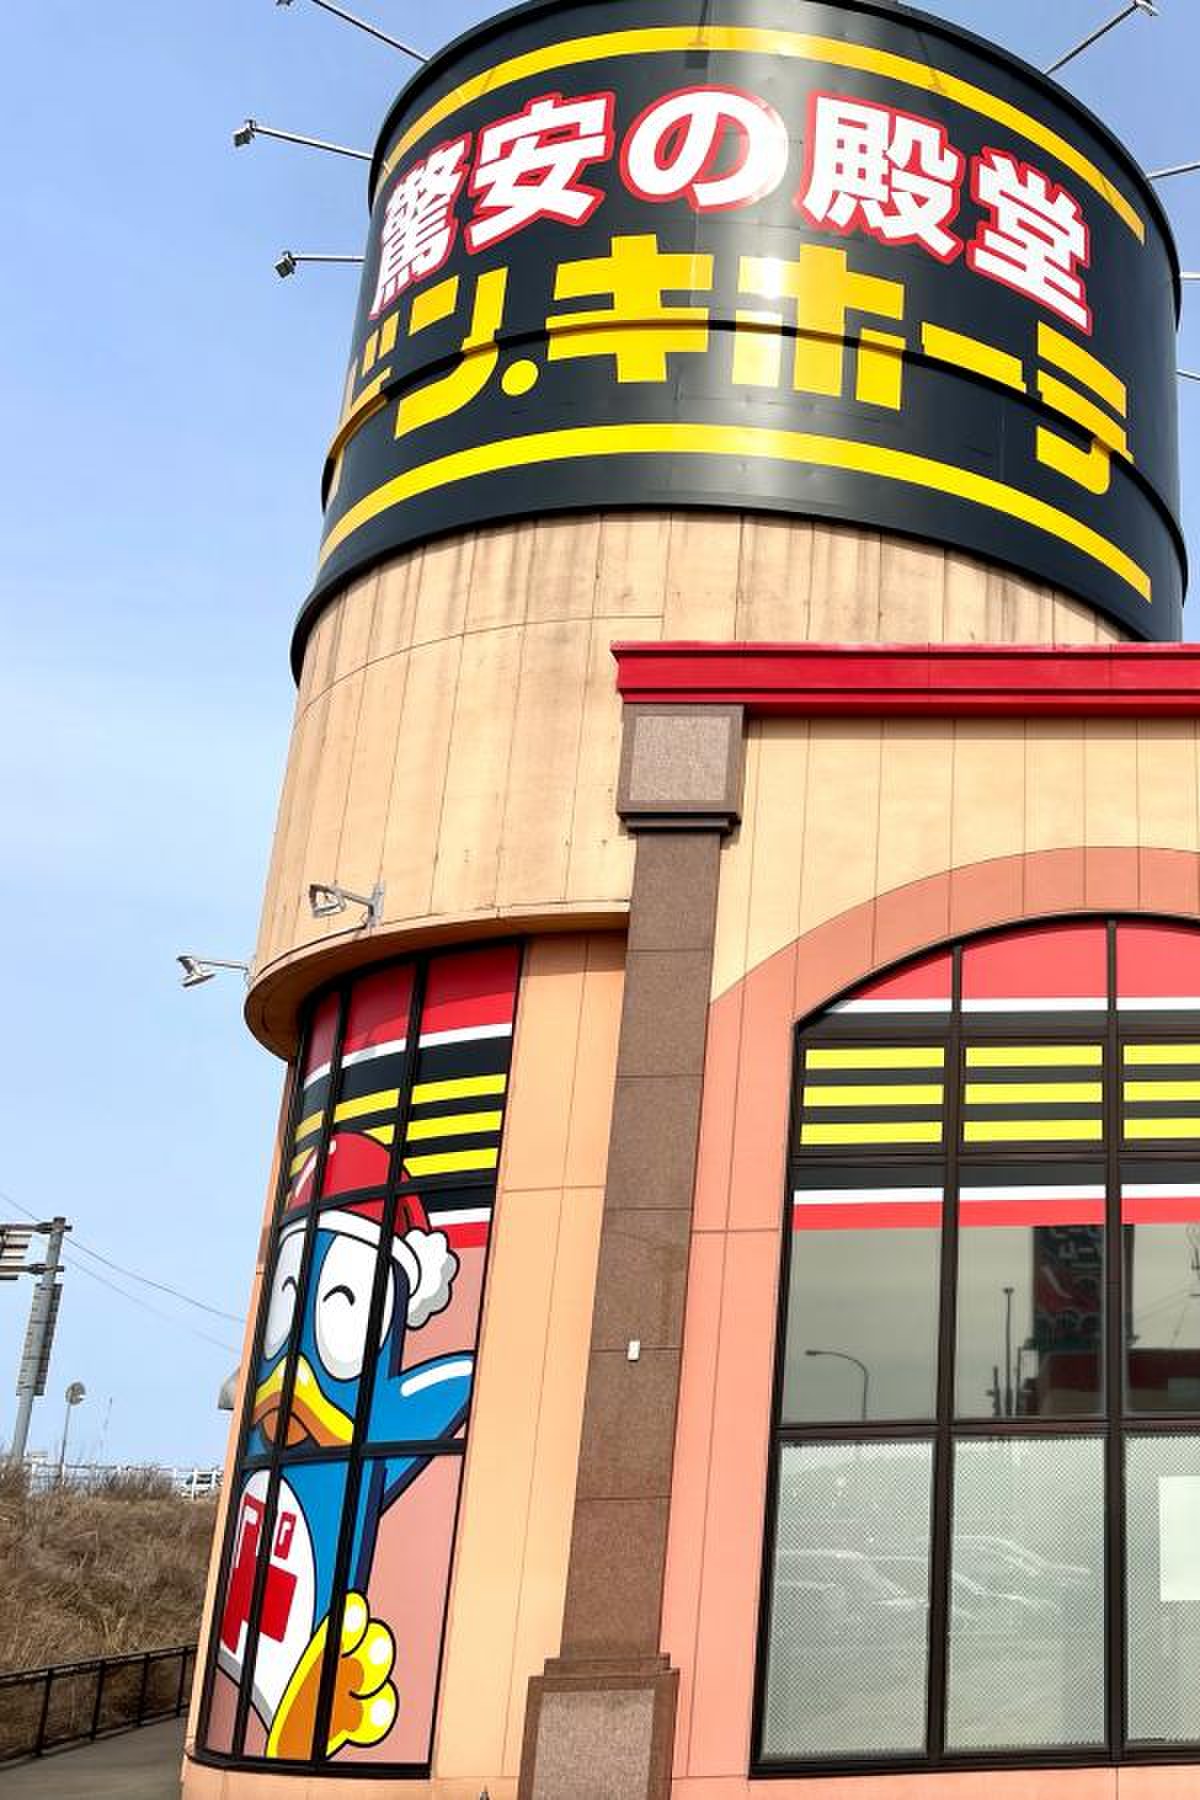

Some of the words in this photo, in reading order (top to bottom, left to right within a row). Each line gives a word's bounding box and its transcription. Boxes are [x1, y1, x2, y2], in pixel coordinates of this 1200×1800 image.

[368, 84, 1093, 336] 驚安の殿堂
